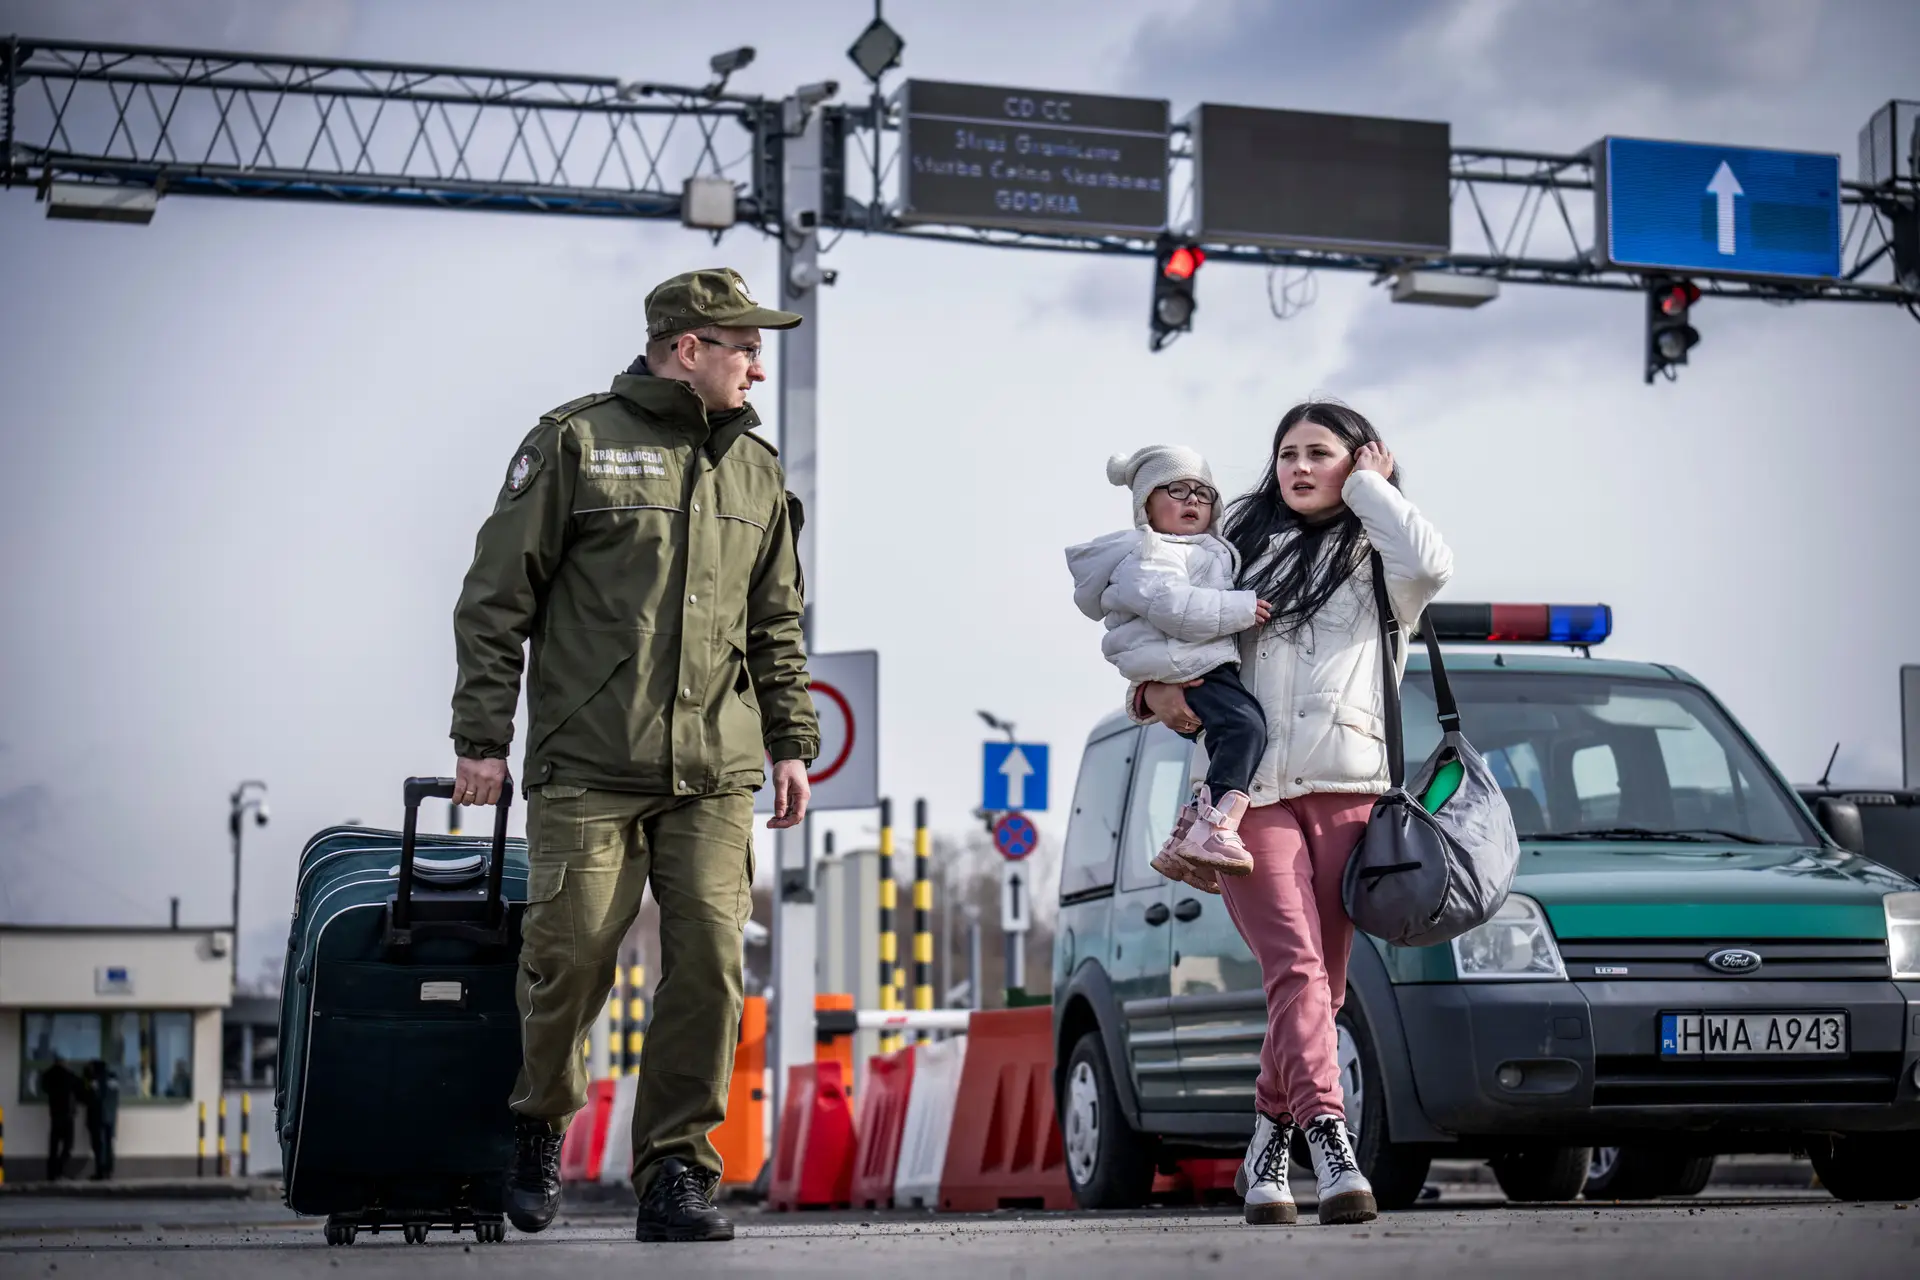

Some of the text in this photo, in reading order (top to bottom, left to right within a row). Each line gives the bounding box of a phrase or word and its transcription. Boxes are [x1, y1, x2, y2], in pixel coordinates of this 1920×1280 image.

[1003, 96, 1072, 121] CD CC
[615, 450, 664, 464] GRANICZNA
[590, 463, 614, 474] POLISH
[1722, 953, 1750, 967] Ford
[1682, 1017, 1841, 1051] HWA A943
[1663, 1038, 1676, 1049] PL
